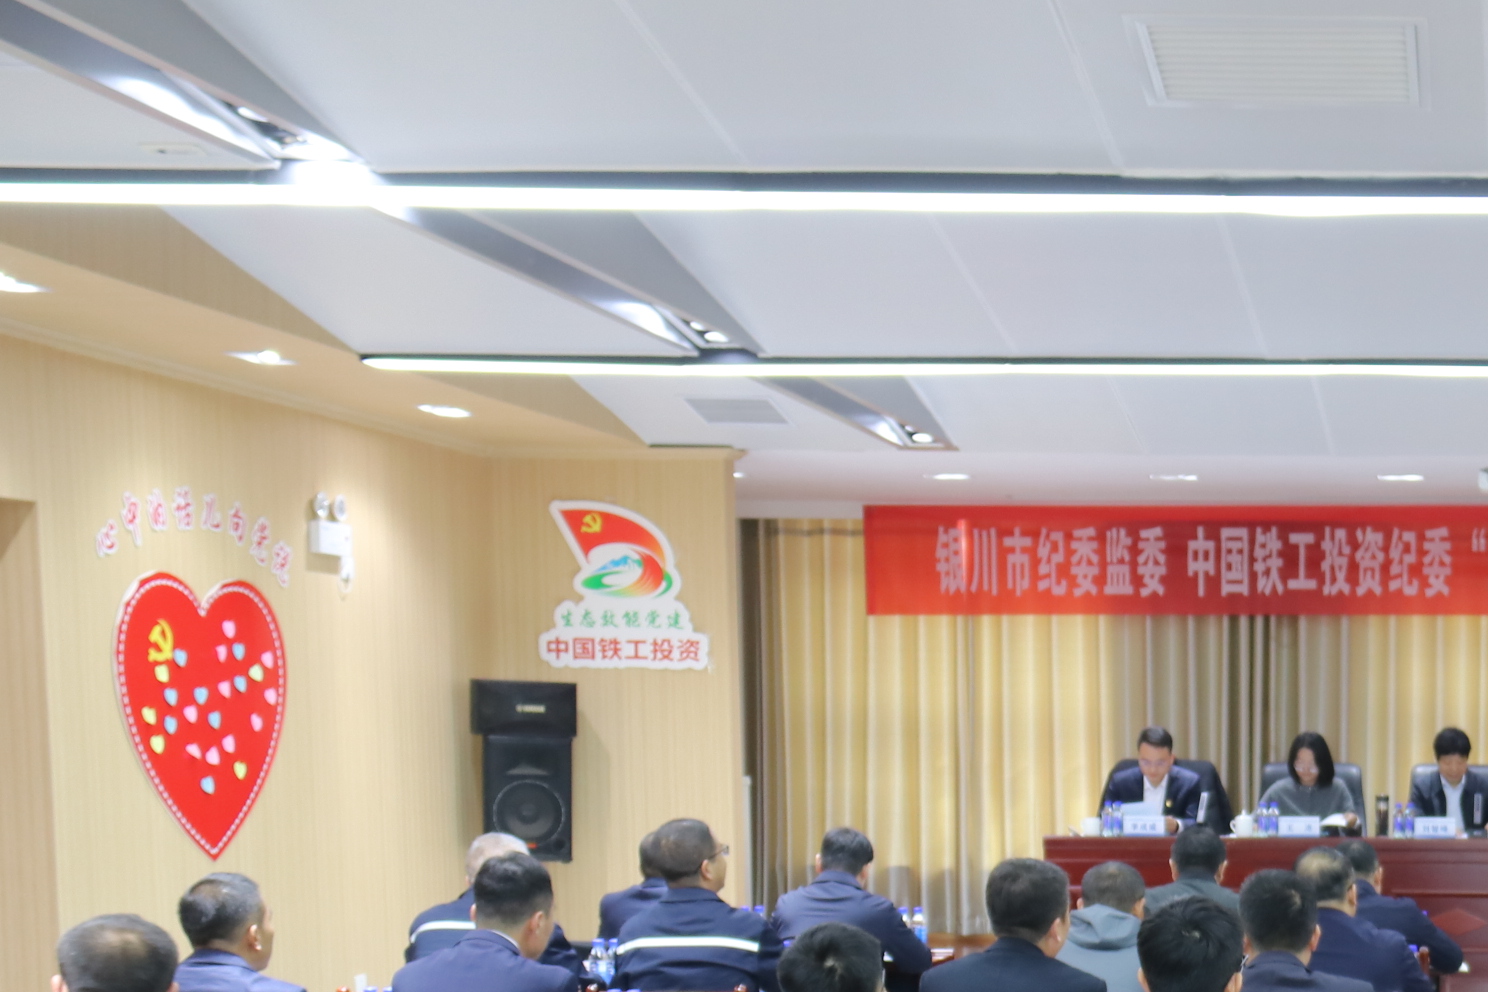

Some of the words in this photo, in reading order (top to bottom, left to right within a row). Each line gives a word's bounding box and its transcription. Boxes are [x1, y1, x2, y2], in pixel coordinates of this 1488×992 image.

[935, 525, 1167, 597] 银川市纪委监委
[1187, 526, 1452, 598] 中国铁工投资纪委
[546, 636, 701, 662] 中国铁工投资
